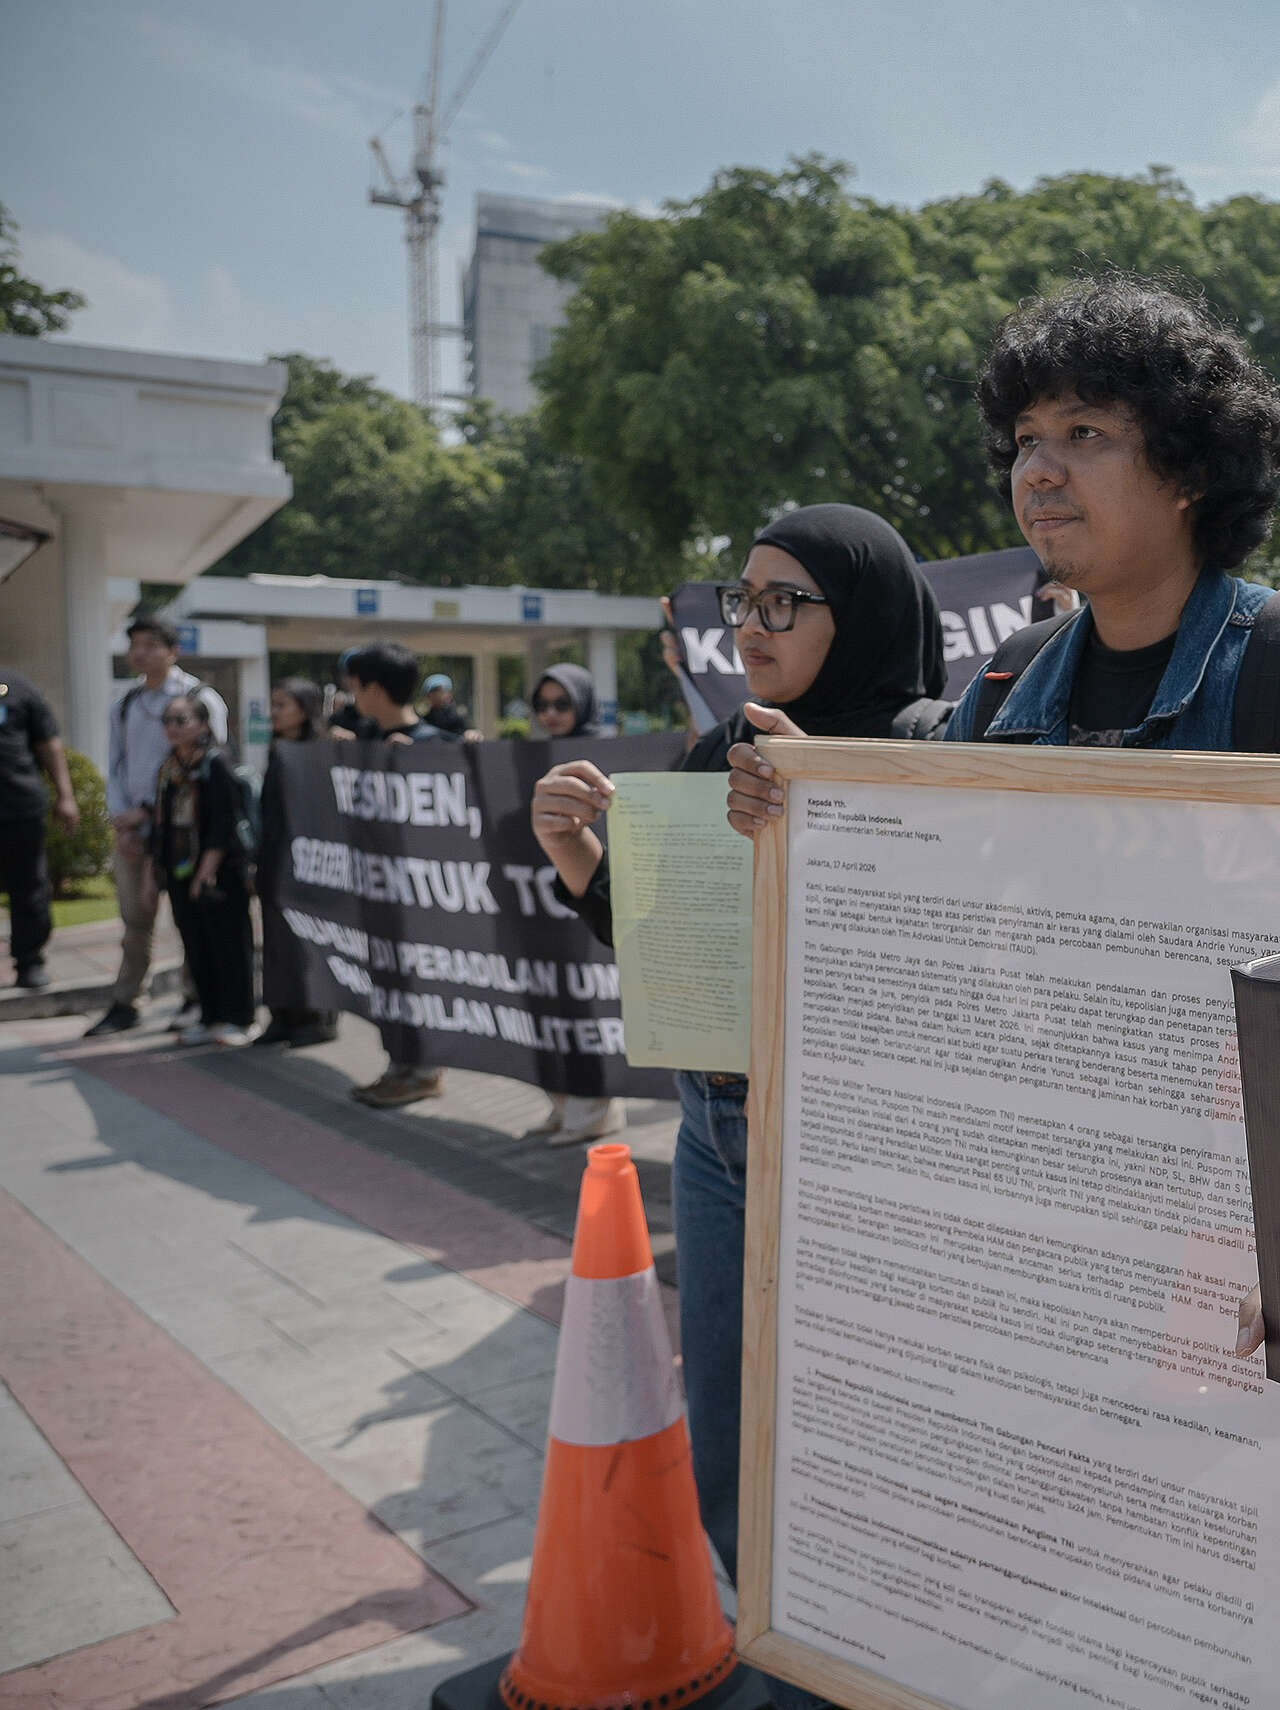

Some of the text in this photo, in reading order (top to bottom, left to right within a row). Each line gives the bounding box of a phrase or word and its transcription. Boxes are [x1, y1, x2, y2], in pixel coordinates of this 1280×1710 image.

[807, 796, 832, 808] Kepada
[807, 809, 903, 825] Presiden Republik Indonesia
[833, 860, 840, 868] 17
[841, 861, 858, 872] April
[858, 862, 877, 872] 2026
[887, 890, 902, 901] sipil
[903, 893, 920, 904] yang
[921, 894, 944, 904] terdiri
[945, 896, 960, 906] dari
[961, 900, 983, 909] unsur
[1054, 910, 1086, 921] pemuka
[1119, 916, 1135, 926] dan
[1137, 920, 1183, 932] perwakilan
[1185, 925, 1229, 937] organisasi
[881, 927, 897, 936] oleh
[898, 928, 911, 938] Tim
[912, 930, 944, 942] Advokasi
[944, 934, 967, 945] Untuk
[967, 937, 1008, 951] Demokrasi
[895, 916, 929, 928] kejahatan
[932, 921, 973, 933] terorganisir
[976, 925, 991, 936] dan
[994, 930, 1032, 941] mengarah
[1035, 934, 1055, 944] pada
[1058, 938, 1102, 949] percobaan
[1105, 943, 1160, 957] pembunuhan
[903, 904, 921, 916] sikap
[923, 907, 942, 918] tegas
[944, 910, 960, 919] atas
[961, 912, 996, 923] peristiwa
[998, 917, 1044, 929] penyiraman
[1046, 921, 1056, 930] air
[1059, 922, 1080, 933] keras
[1082, 927, 1102, 938] yang
[1104, 928, 1134, 940] dialami
[1136, 932, 1156, 942] oleh
[1158, 934, 1193, 947] Saudara
[1196, 939, 1225, 951] Andrie
[1024, 971, 1200, 1003] telah melakukan pendalaman dan proses
[1082, 992, 1108, 1004] Selain
[1124, 998, 1167, 1013] kepolisian
[1168, 1004, 1186, 1017] juga
[1104, 1009, 1213, 1034] terungkap dan penetapan
[962, 1013, 971, 1022] 13
[974, 1015, 996, 1026] Maret
[1122, 1038, 1145, 1050] kasus
[1149, 1044, 1169, 1056] yang
[1172, 1048, 1213, 1063] menimpa
[1096, 1023, 1220, 1048] meningkatkan status proses
[1020, 1061, 1240, 1109] Andrie Yunus sebagai korban sehingga seharusnya
[1180, 1105, 1236, 1121] yang dijamin
[1102, 1130, 1245, 1165] sebagai tersangka penyiraman air
[1161, 1155, 1178, 1166] aksi
[1196, 1161, 1232, 1176] Puspom
[1188, 1173, 1210, 1186] BHW
[1213, 1178, 1231, 1190] dan
[1190, 1228, 1245, 1249] harus diadili
[1186, 1268, 1226, 1286] hak asasi
[1170, 1292, 1214, 1311] HAM dan
[1181, 1349, 1264, 1380] banyaknya distorsi
[1179, 1364, 1263, 1396] untuk mengungkap
[1152, 1410, 1170, 1422] rasa
[1067, 1448, 1258, 1517] Fakta sipil
[1227, 1512, 1258, 1530] korban
[1060, 1536, 1075, 1549] TNI
[1195, 1542, 1256, 1571] harus disertai
